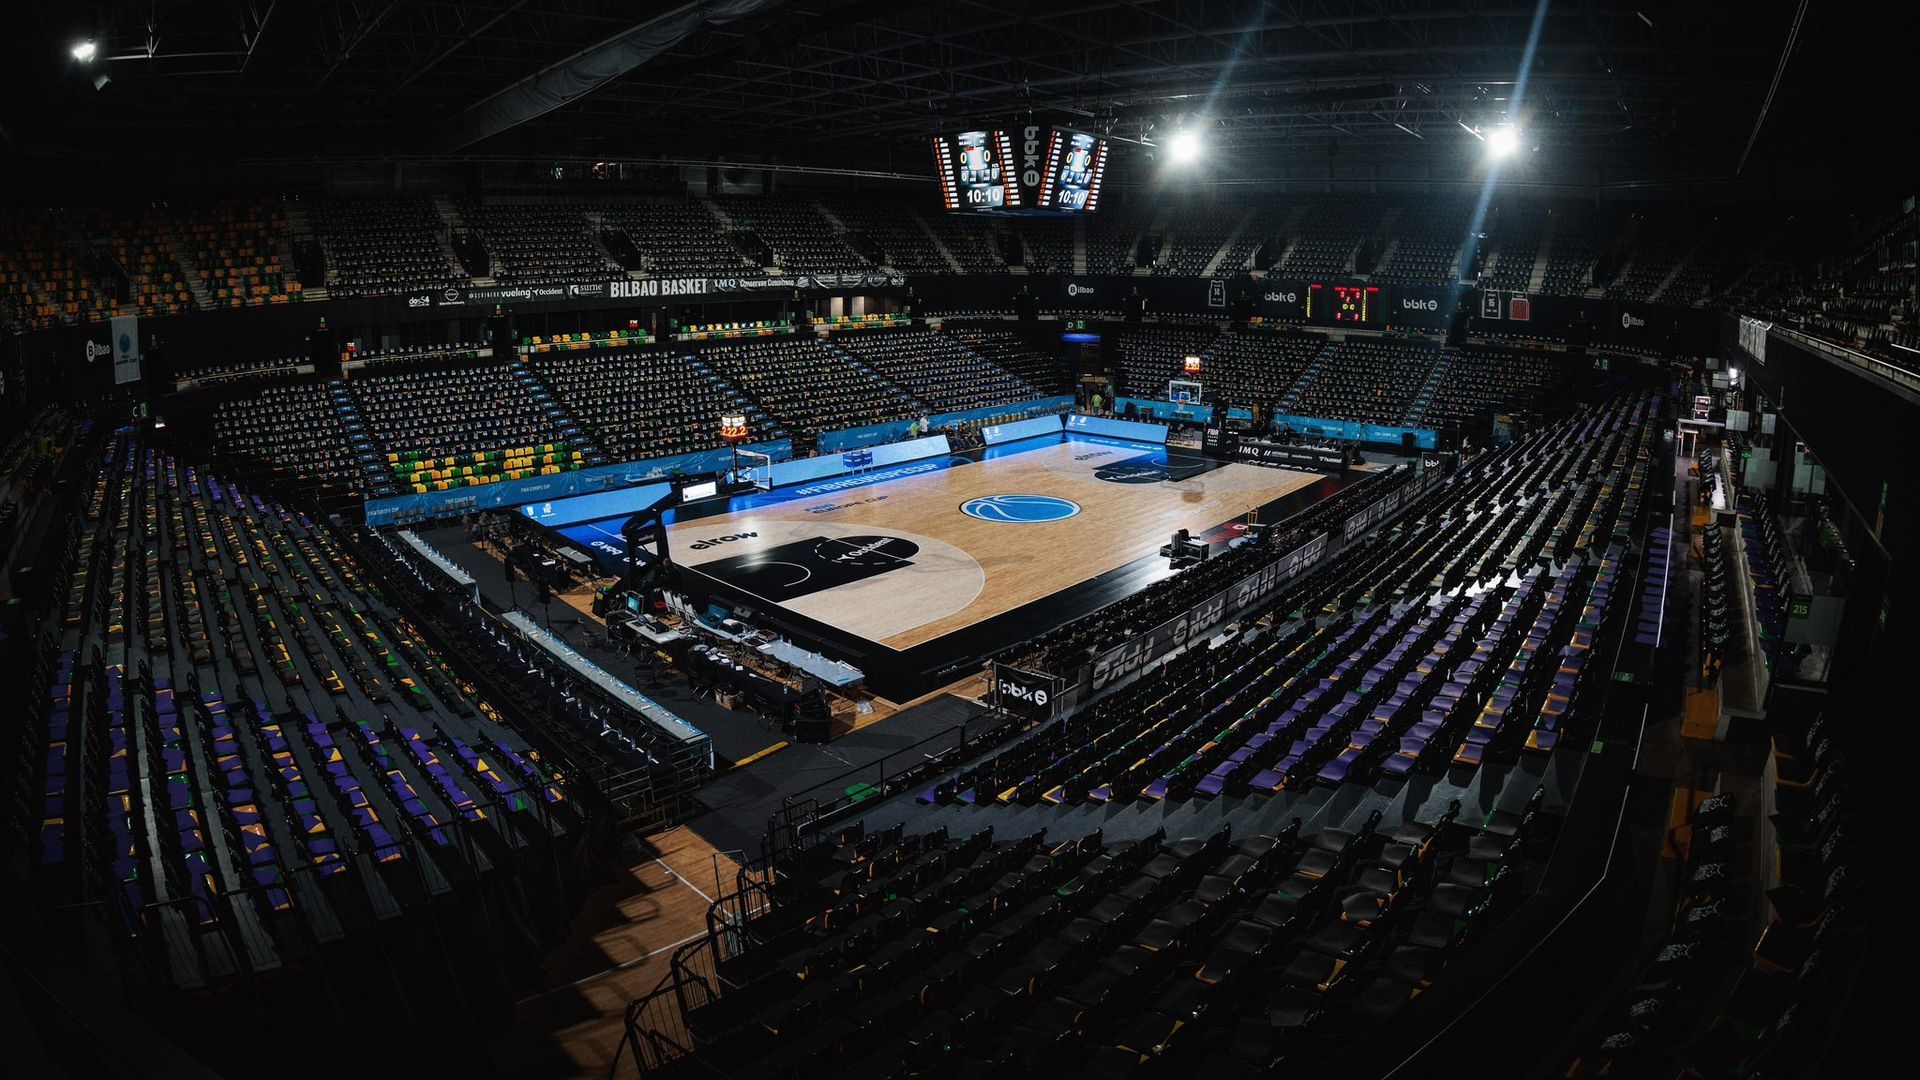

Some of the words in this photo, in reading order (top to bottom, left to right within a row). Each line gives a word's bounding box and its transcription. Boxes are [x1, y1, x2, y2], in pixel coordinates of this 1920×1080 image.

[960, 152, 967, 164] 0
[983, 150, 991, 162] 0
[967, 189, 1000, 203] 10:10
[1058, 189, 1085, 204] 10:10
[610, 280, 657, 298] BILBAO
[662, 278, 707, 295] BASKET
[714, 279, 737, 289] IMQ
[501, 287, 531, 299] vueling
[1239, 446, 1259, 456] IMQ
[690, 532, 758, 550] elrow
[1793, 605, 1808, 615] 215
